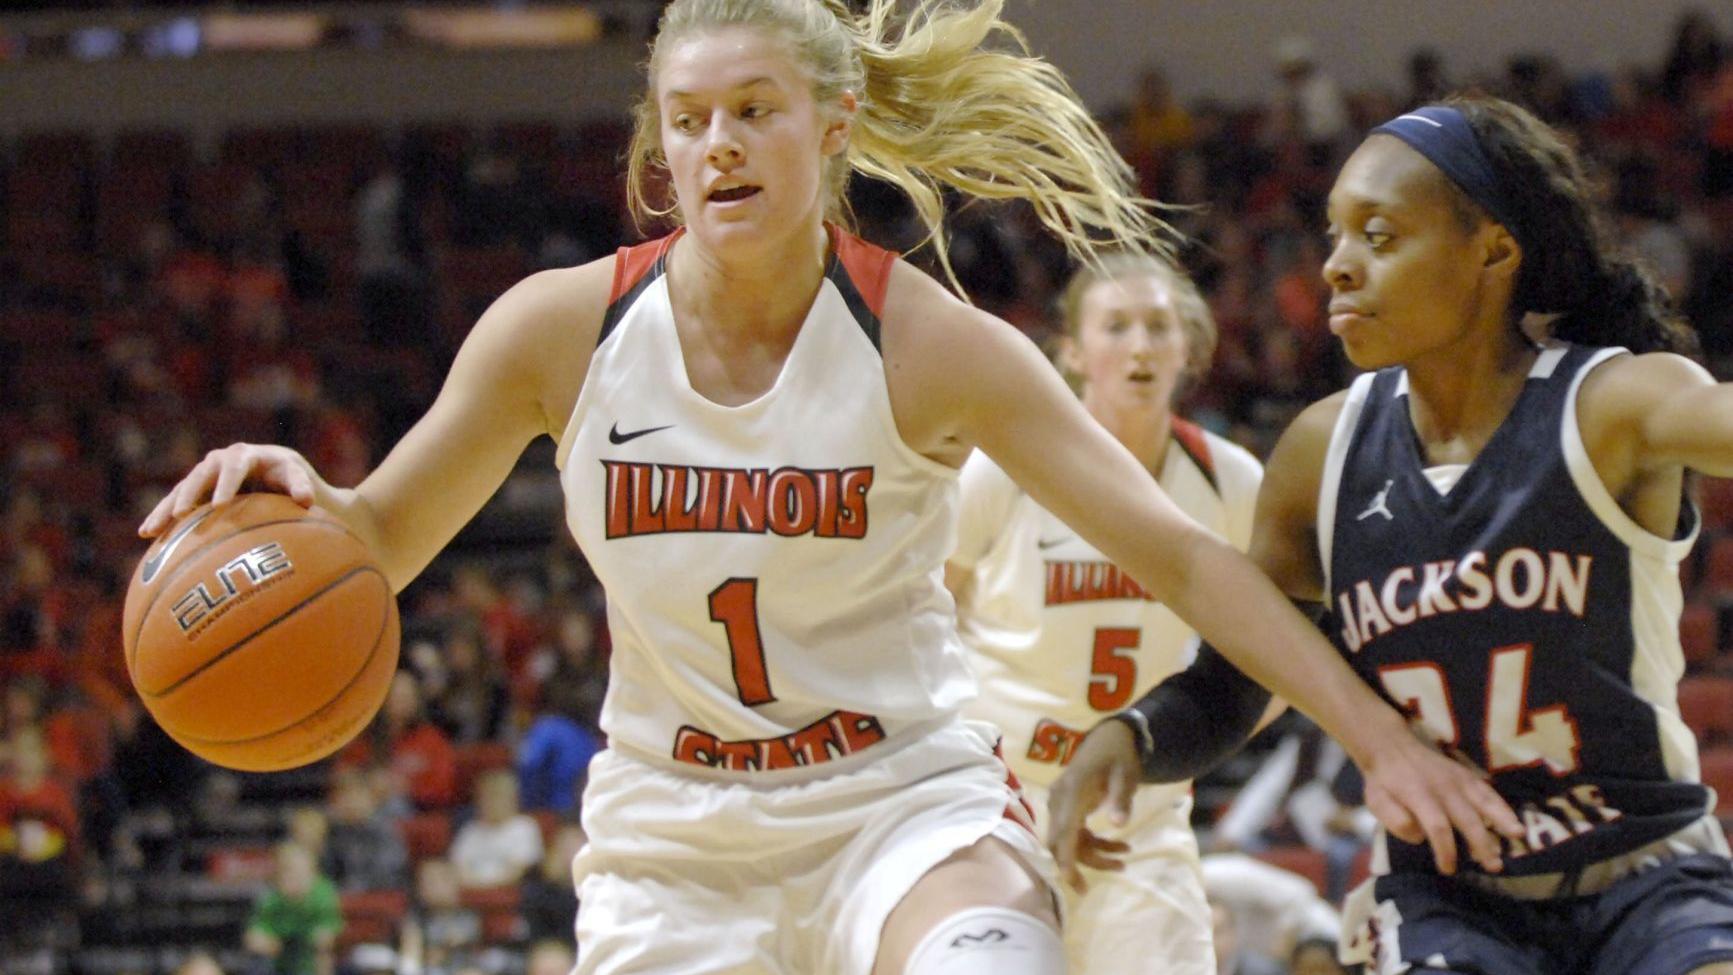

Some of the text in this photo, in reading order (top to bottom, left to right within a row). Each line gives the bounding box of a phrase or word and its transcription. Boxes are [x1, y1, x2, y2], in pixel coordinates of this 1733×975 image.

[600, 459, 874, 540] ILLINOIS
[170, 541, 293, 634] ELITE
[1339, 548, 1592, 653] JACKSON
[708, 577, 778, 707] 1
[1087, 627, 1142, 712] 5
